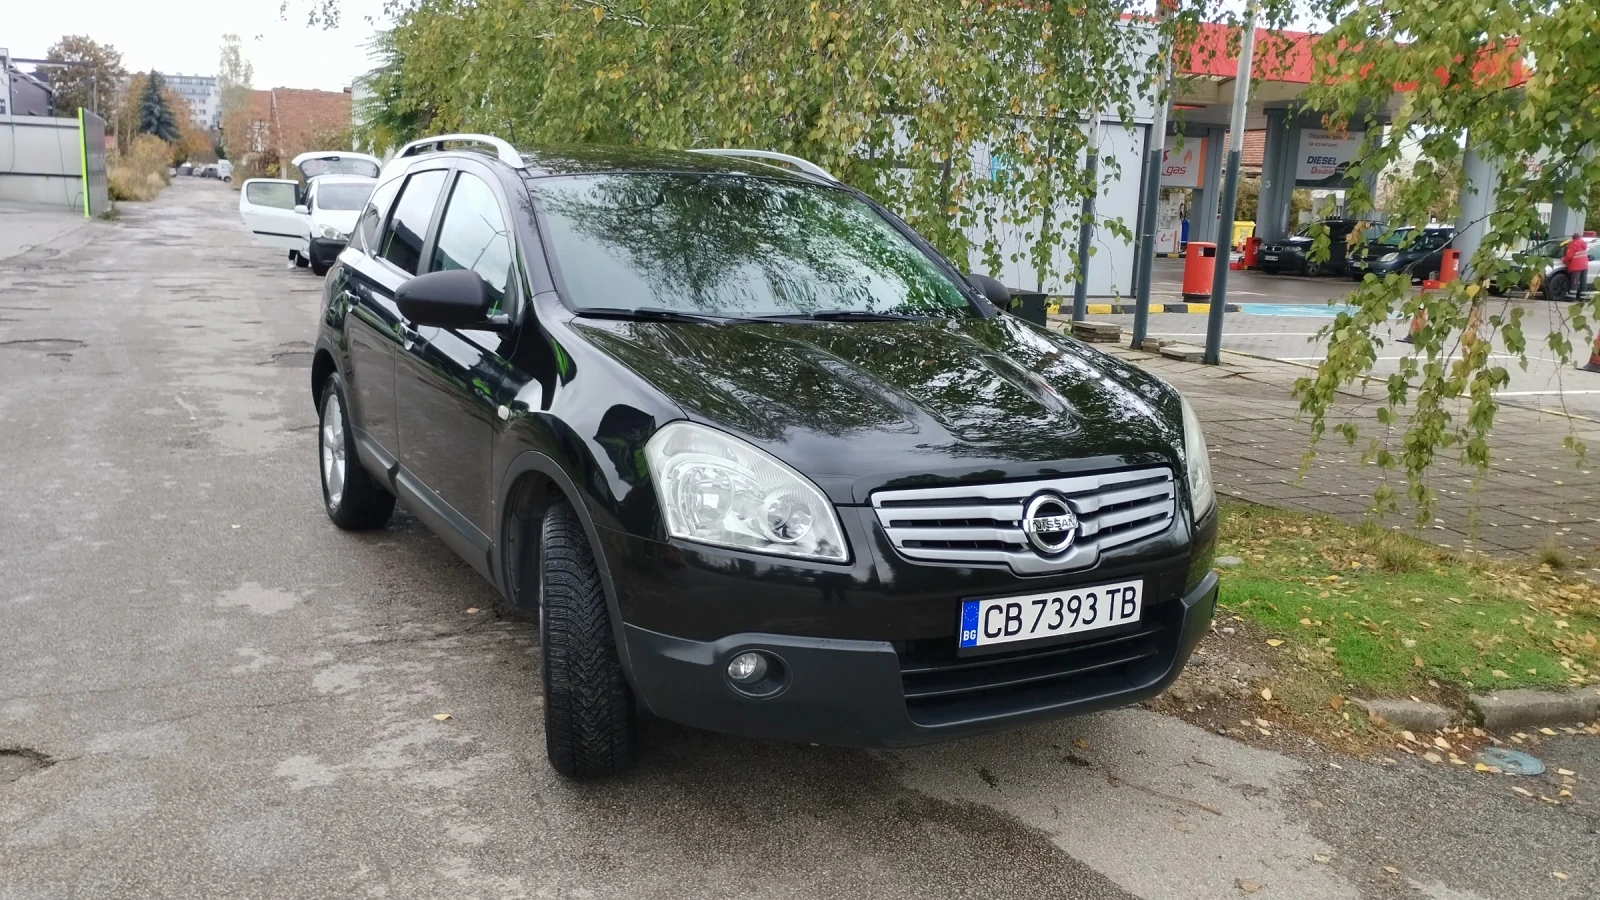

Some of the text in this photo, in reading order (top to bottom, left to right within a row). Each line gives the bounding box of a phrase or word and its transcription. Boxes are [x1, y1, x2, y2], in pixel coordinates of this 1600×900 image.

[1307, 155, 1338, 165] DIESEL
[1165, 166, 1187, 176] gas
[1310, 166, 1335, 175] Double
[1265, 180, 1271, 188] 3
[1032, 518, 1076, 531] NISSAN
[983, 586, 1137, 639] CB 7393 TB
[963, 629, 977, 641] BG
